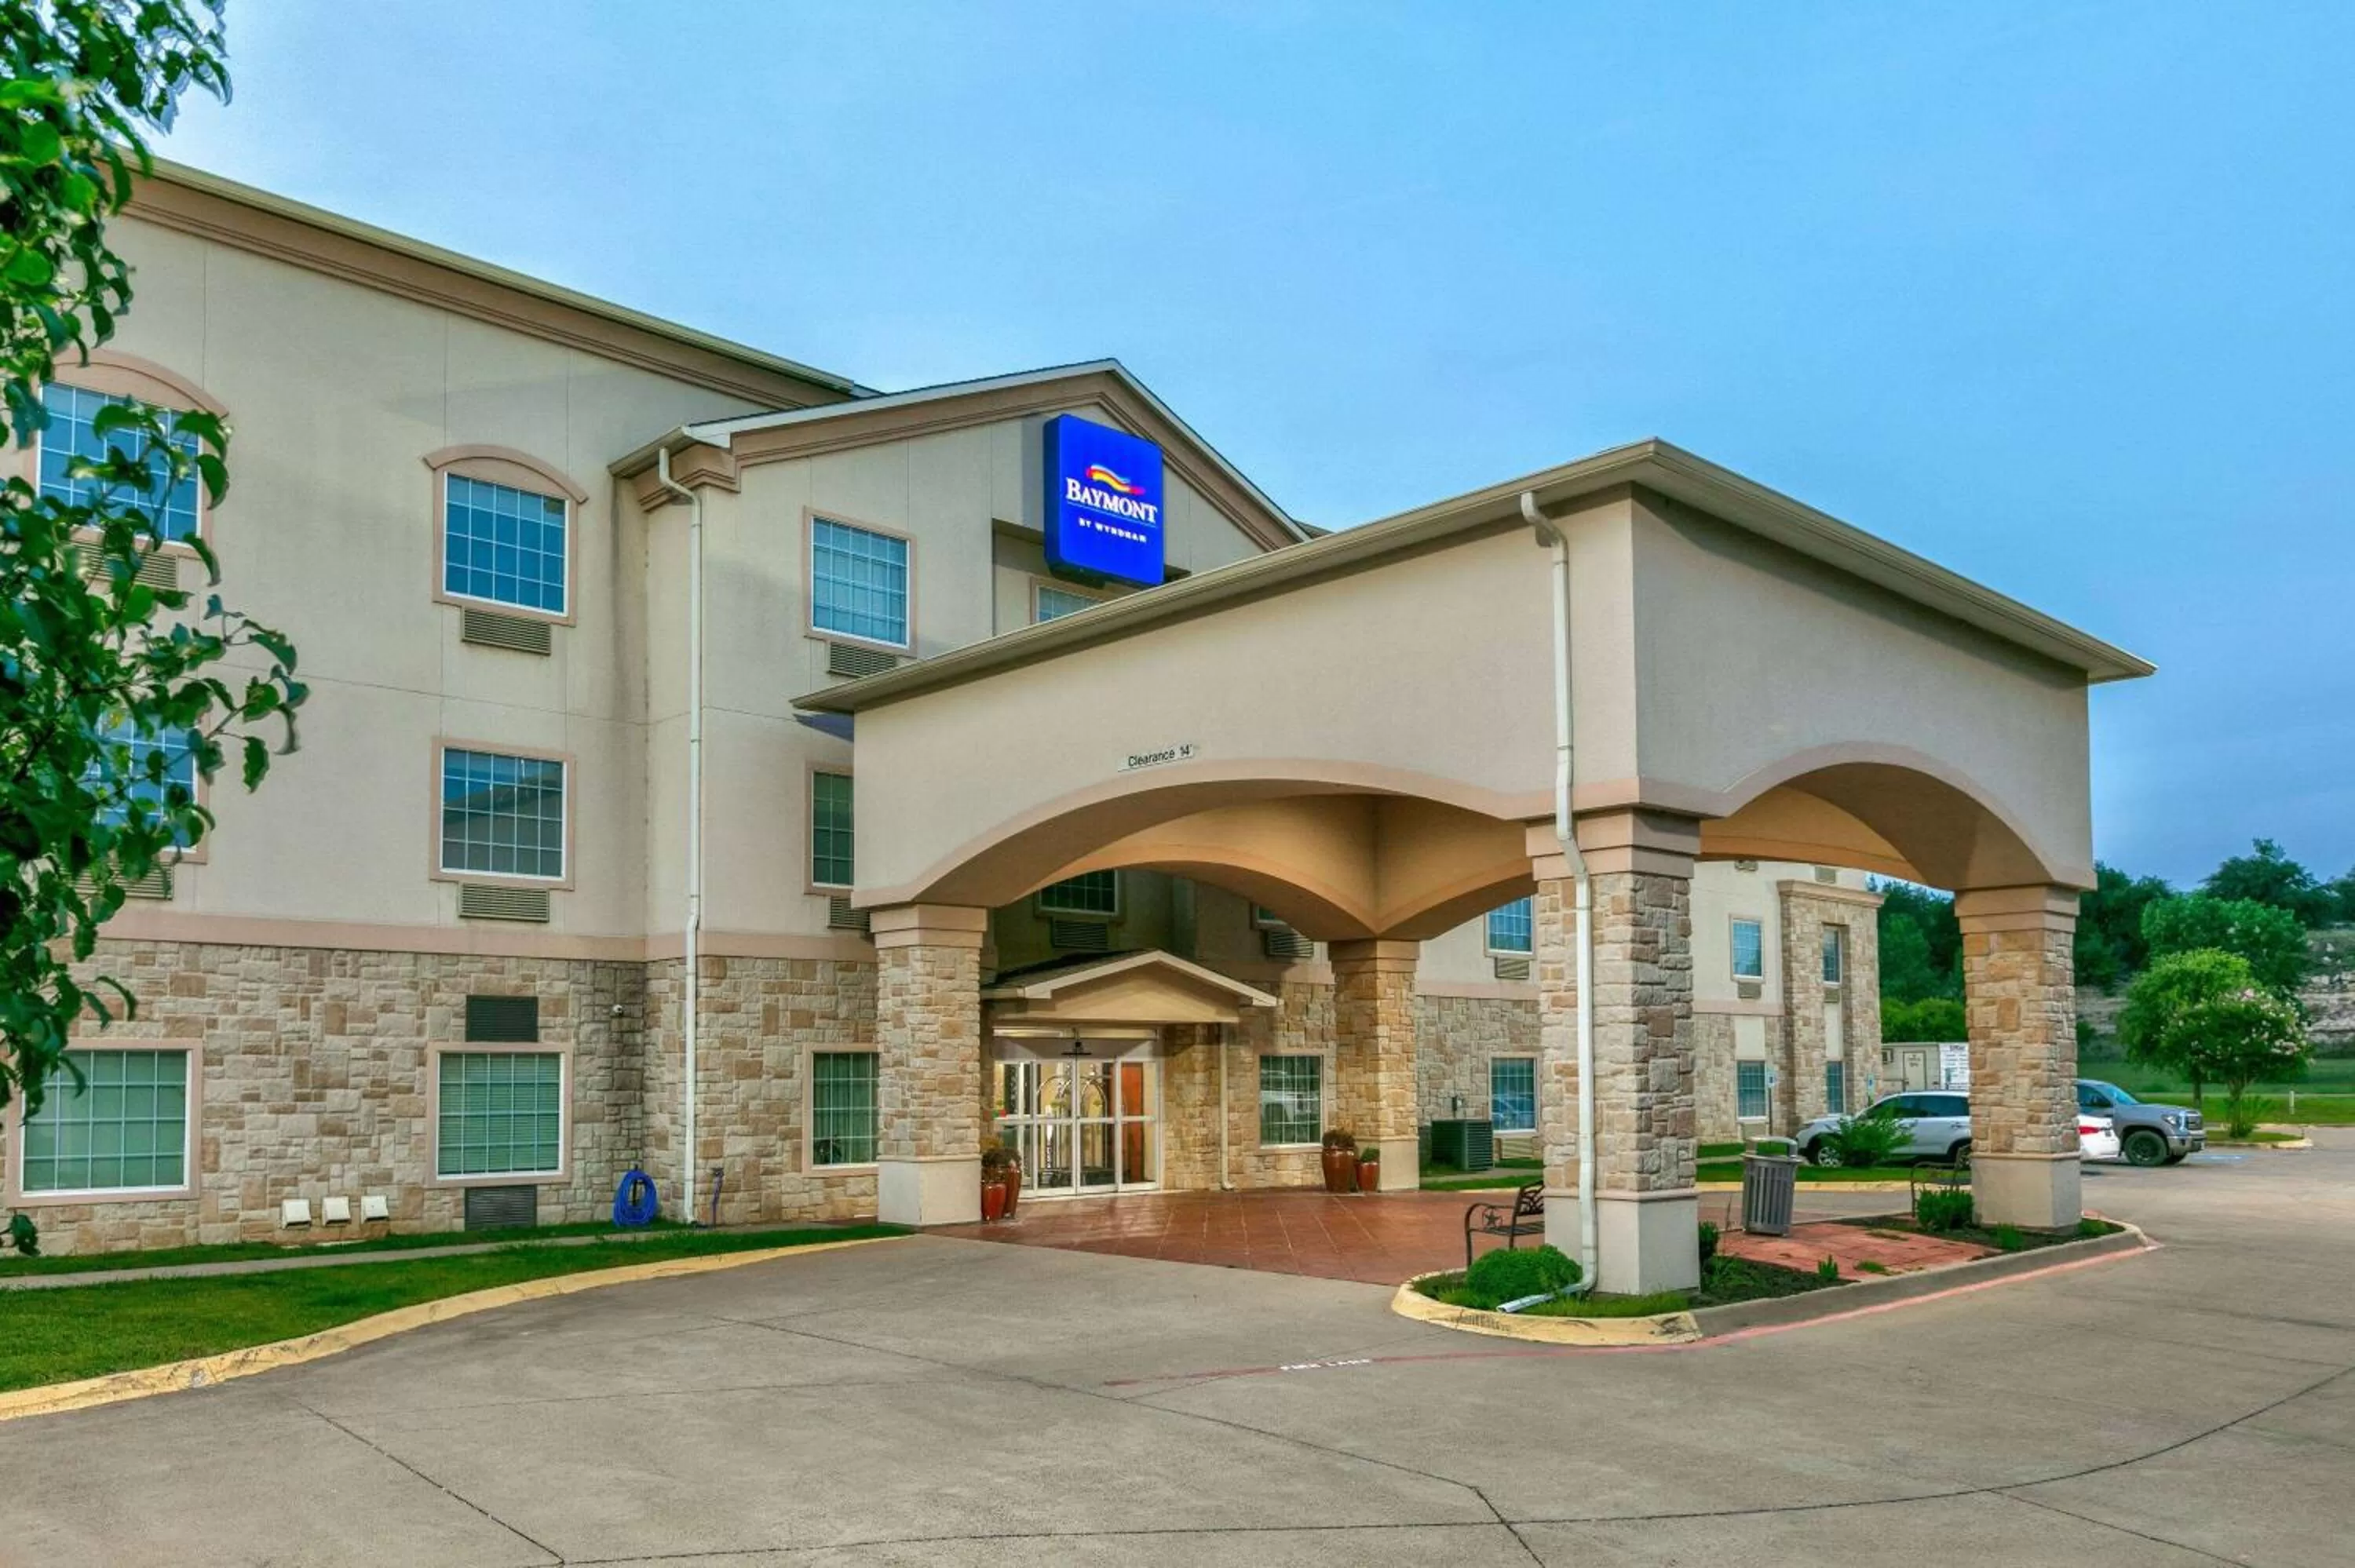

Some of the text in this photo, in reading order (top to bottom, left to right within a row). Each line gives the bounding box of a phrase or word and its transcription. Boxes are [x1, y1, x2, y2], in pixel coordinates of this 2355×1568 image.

[1065, 477, 1158, 524] BAYMONT
[1079, 517, 1147, 543] BY WYNDHAM
[1128, 749, 1175, 767] Clearance
